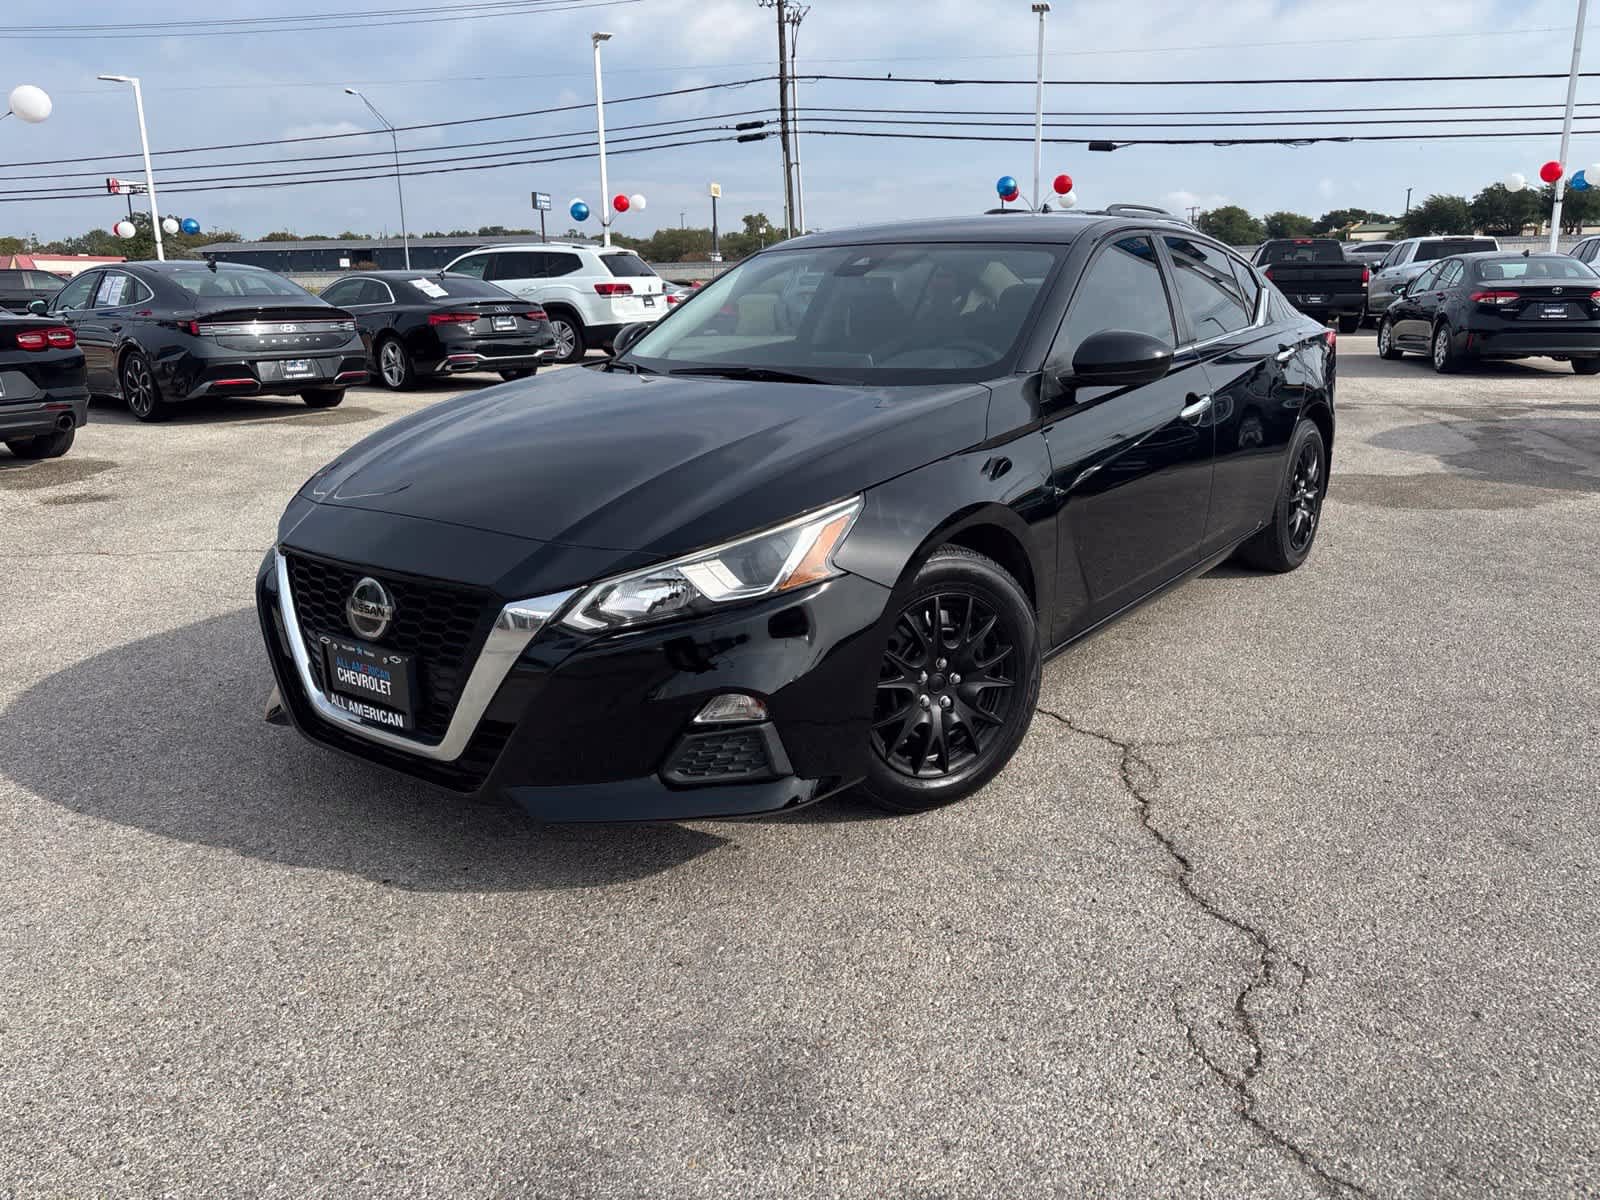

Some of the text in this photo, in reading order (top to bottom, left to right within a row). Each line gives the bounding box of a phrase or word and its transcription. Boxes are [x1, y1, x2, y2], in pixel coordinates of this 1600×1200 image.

[351, 602, 385, 617] NISSAN
[335, 656, 391, 681] ALL AMERICAN
[337, 667, 392, 696] CHEVROLET
[331, 693, 404, 728] ALL AMERICAN
